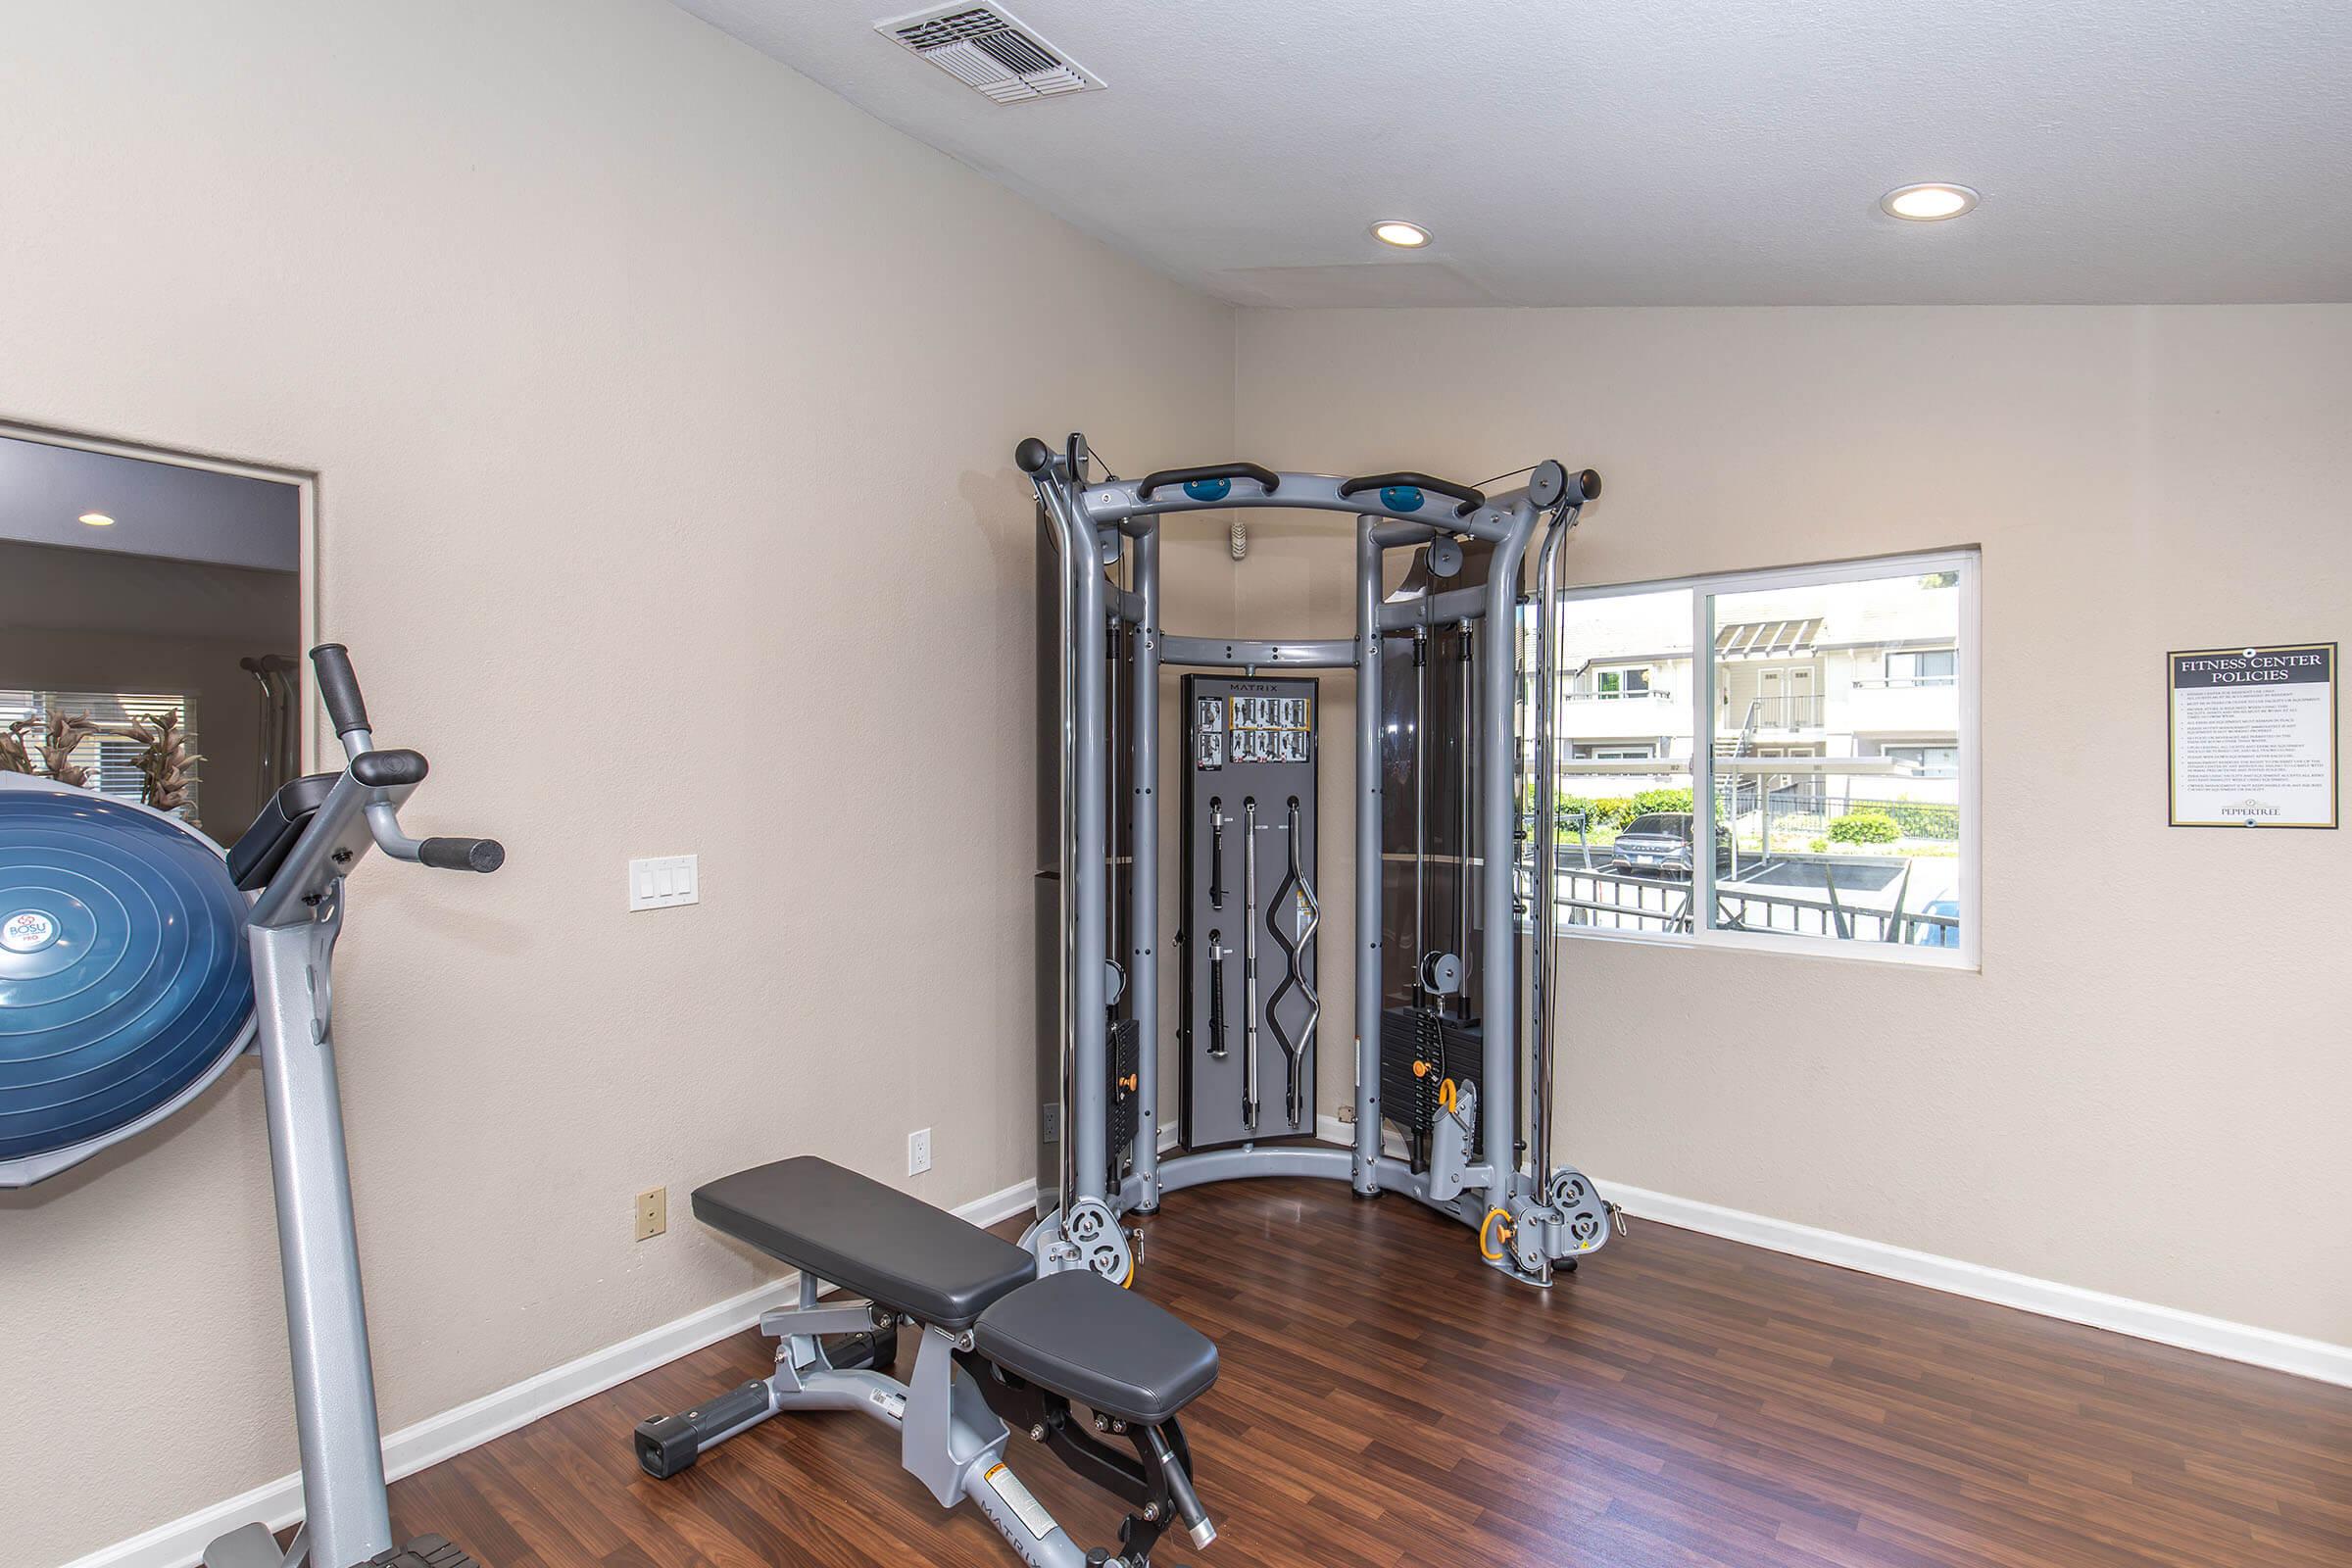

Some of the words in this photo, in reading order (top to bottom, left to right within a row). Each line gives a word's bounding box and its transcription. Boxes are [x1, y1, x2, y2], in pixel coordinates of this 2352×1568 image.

[2181, 659, 2247, 672] FITNESS
[2250, 655, 2322, 668] CENTER
[2212, 669, 2289, 683] POLICIES
[1230, 683, 1278, 692] MATRIX
[2221, 808, 2281, 816] PEPPERTREE
[10, 923, 46, 935] BOSU
